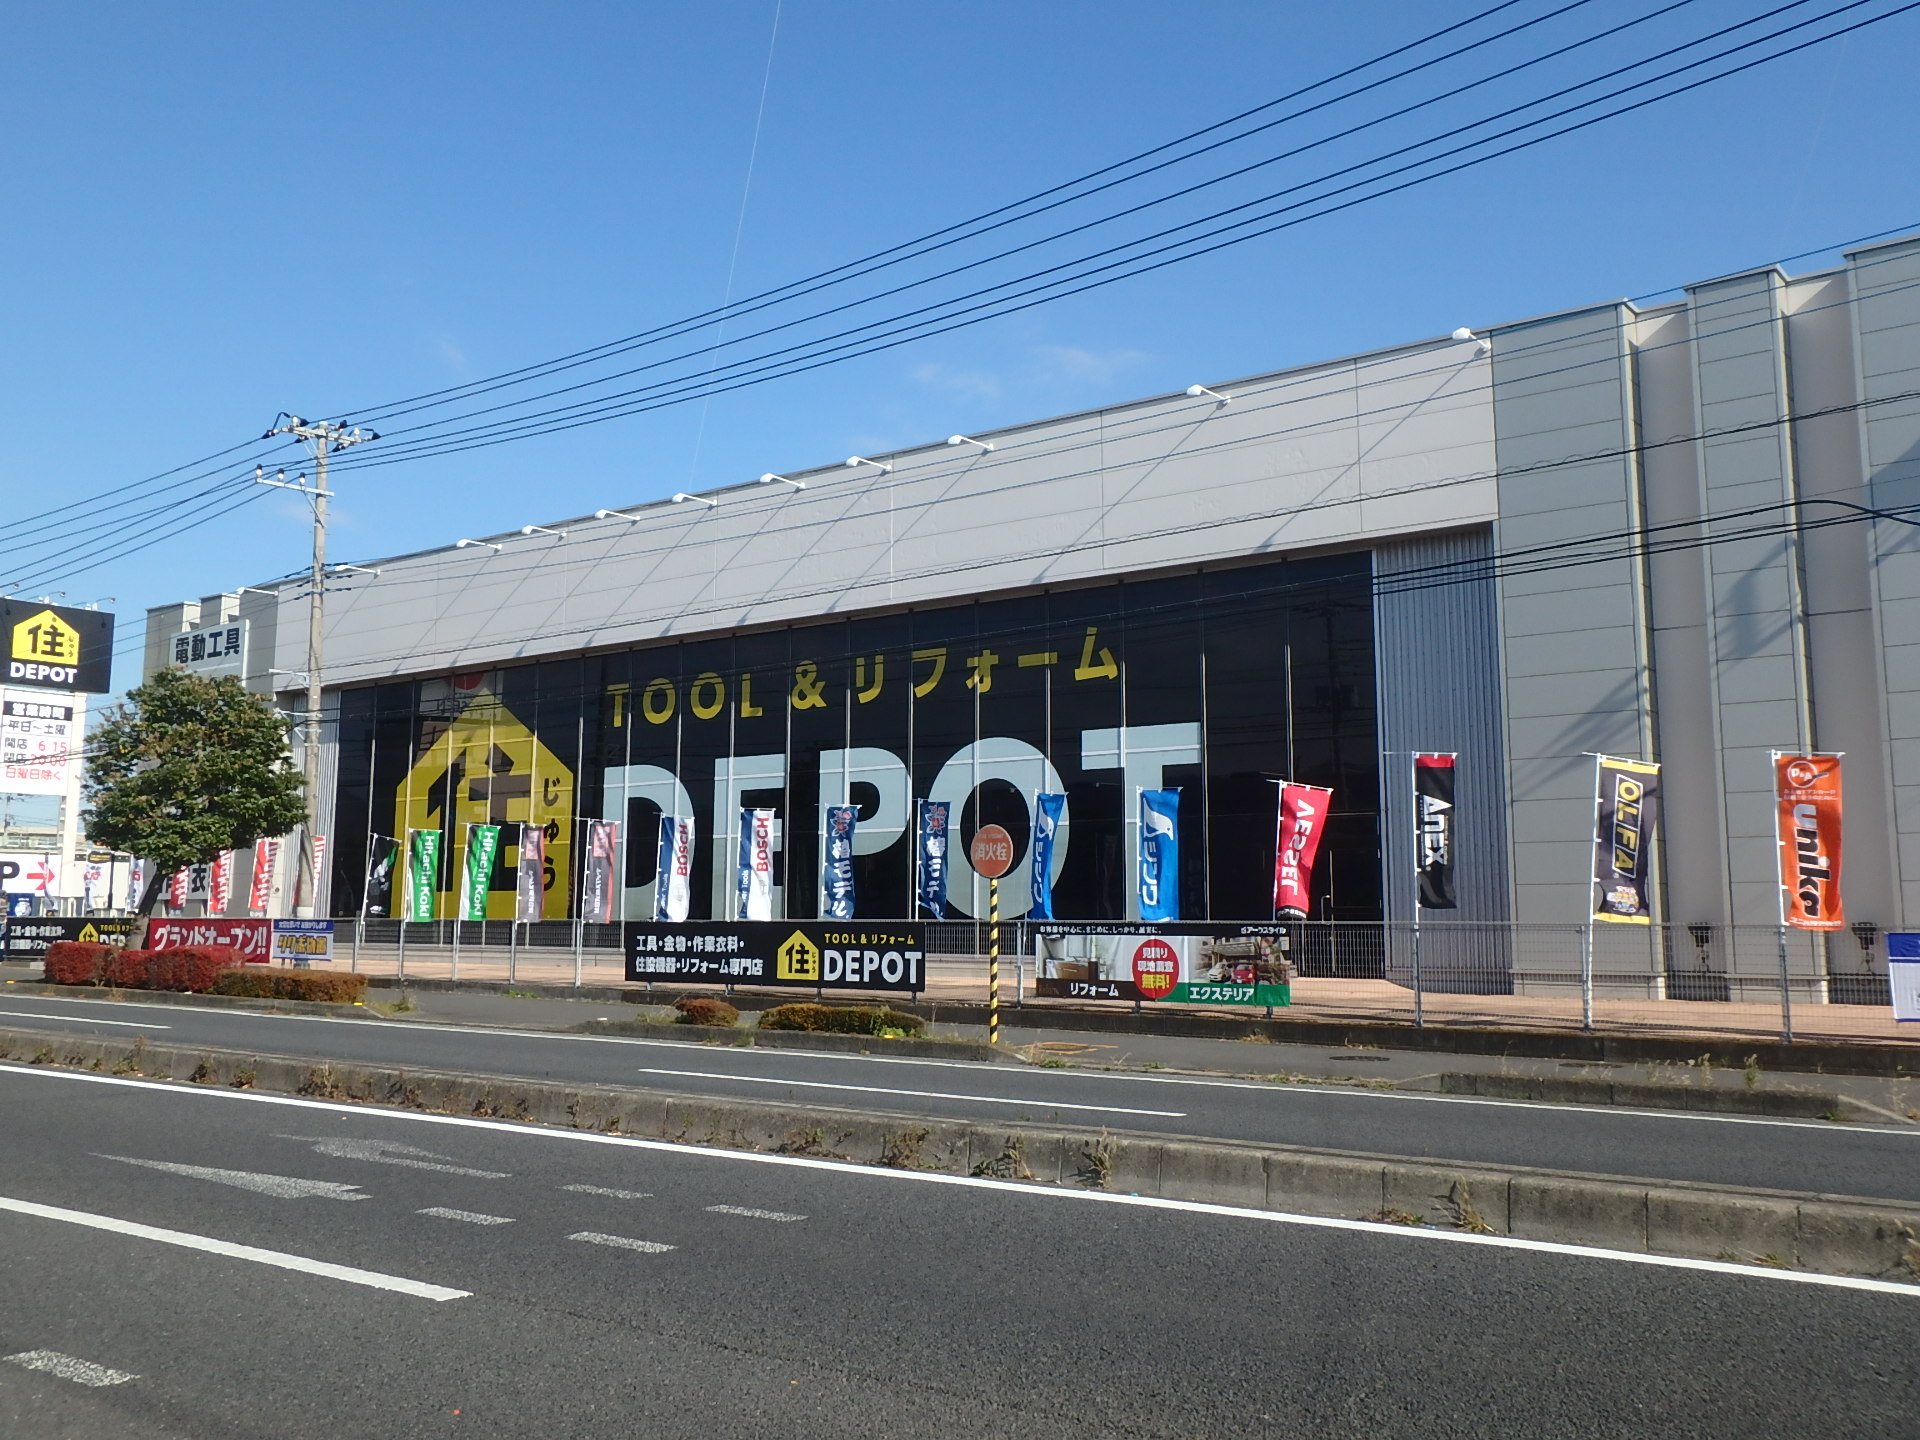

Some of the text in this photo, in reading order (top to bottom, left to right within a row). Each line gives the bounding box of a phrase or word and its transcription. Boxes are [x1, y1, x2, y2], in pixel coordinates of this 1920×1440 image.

[27, 623, 65, 657] 住
[175, 627, 240, 663] 電動工具
[10, 661, 78, 684] DEPOT
[606, 626, 1119, 728] TOOL & リフォーム
[602, 721, 1201, 921] DEPOT
[1614, 781, 1641, 870] OLFA
[676, 823, 689, 877] BOSCH
[756, 817, 770, 872] BOSCH
[975, 842, 1008, 861] 消火栓
[1793, 803, 1831, 919] unika
[419, 835, 435, 917] Hitachi Koki
[473, 831, 494, 916] Hitachi Koki
[824, 933, 859, 944] TOOL
[871, 934, 915, 945] リフォーム
[785, 942, 810, 974] 住
[823, 949, 923, 984] DEPOT
[1070, 982, 1119, 997] リフォーム
[1189, 986, 1255, 1002] エクステリア
